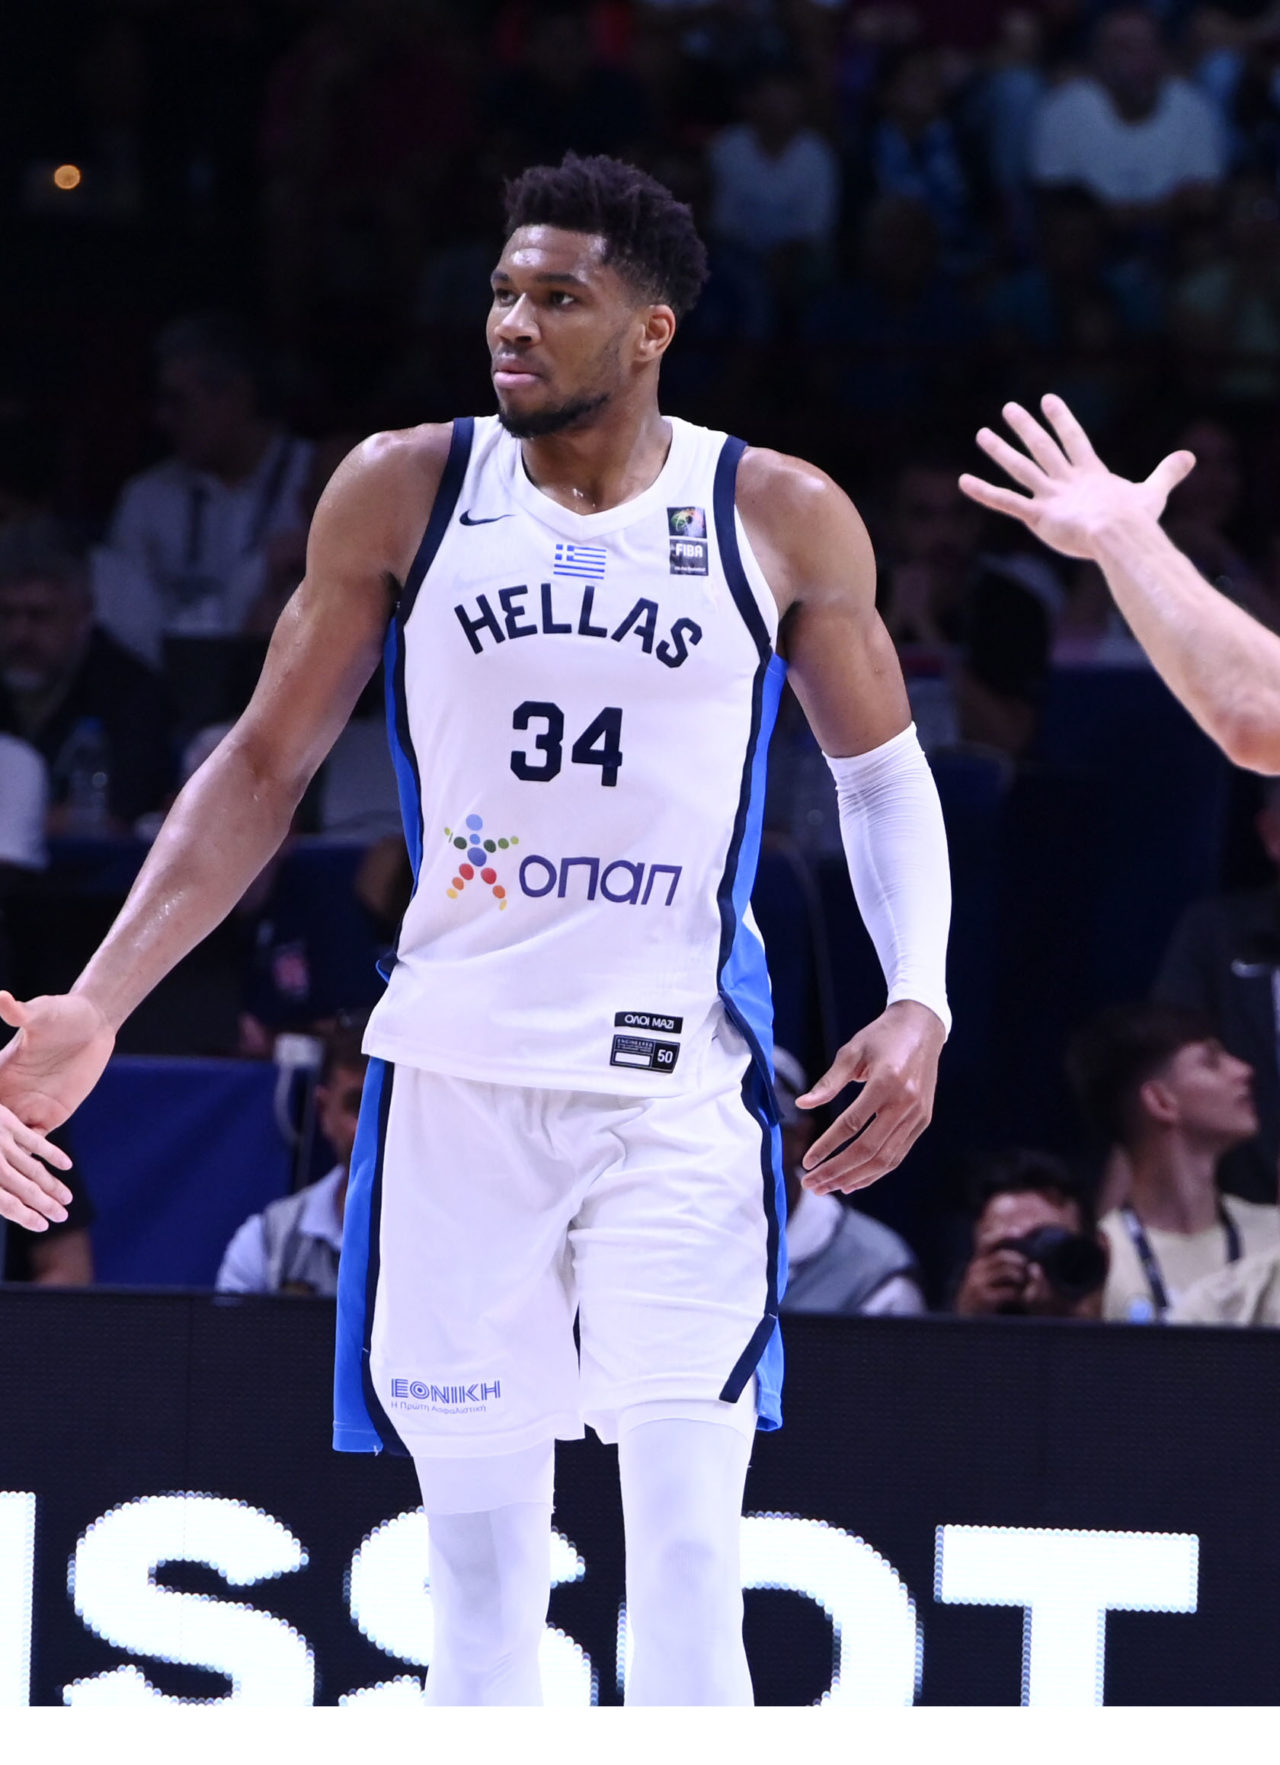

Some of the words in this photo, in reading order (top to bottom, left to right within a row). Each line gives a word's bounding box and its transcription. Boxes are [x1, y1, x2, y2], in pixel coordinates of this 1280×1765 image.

[675, 543, 704, 558] FIBA
[454, 583, 703, 668] HELLAS
[510, 701, 623, 787] 34
[657, 1049, 673, 1063] 50
